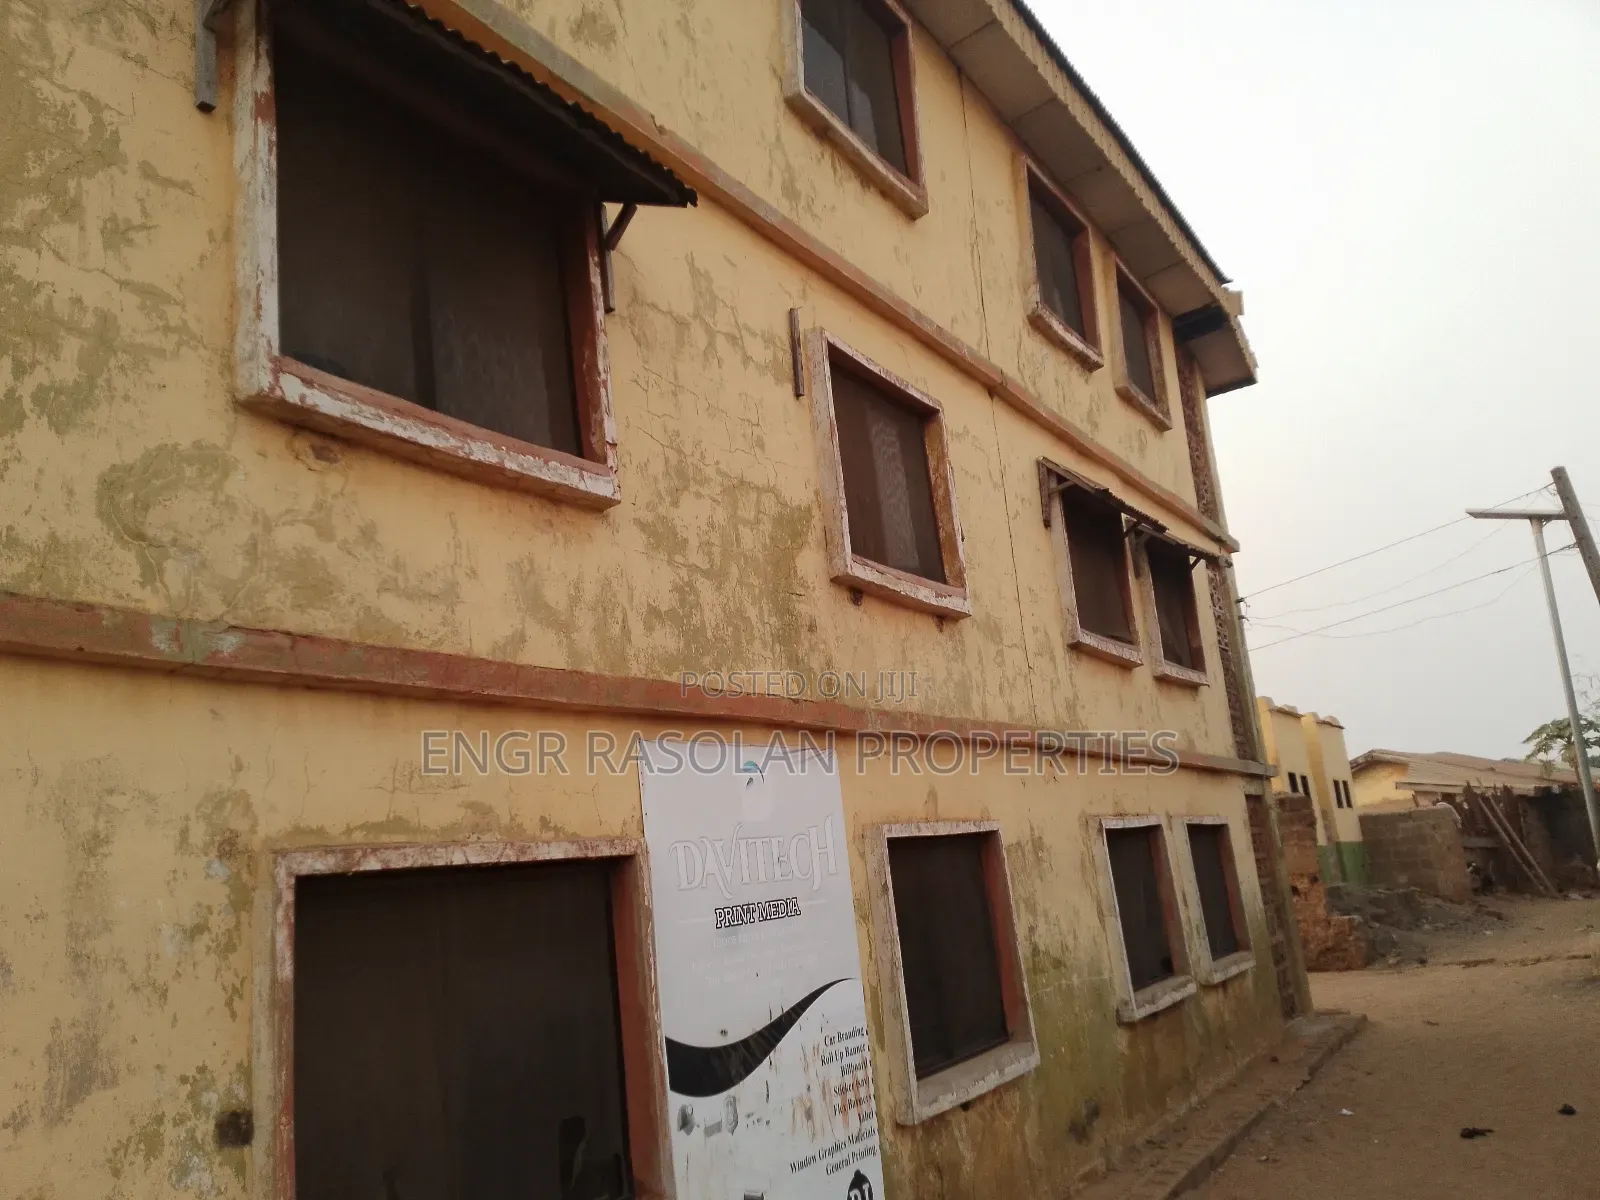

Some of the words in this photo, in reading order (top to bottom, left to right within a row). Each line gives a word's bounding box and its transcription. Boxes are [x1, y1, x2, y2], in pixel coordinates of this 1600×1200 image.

[668, 814, 839, 899] DAVITECH
[715, 902, 756, 929] PRINT
[757, 897, 801, 922] MEDIA
[824, 1034, 836, 1047] Car
[837, 1025, 865, 1043] Branding
[820, 1051, 834, 1067] Roll
[834, 1049, 844, 1063] Up
[844, 1042, 866, 1058] Banner
[789, 1153, 817, 1174] Window
[818, 1140, 847, 1161] Graphics
[847, 1126, 876, 1146] Materials
[825, 1153, 851, 1176] General
